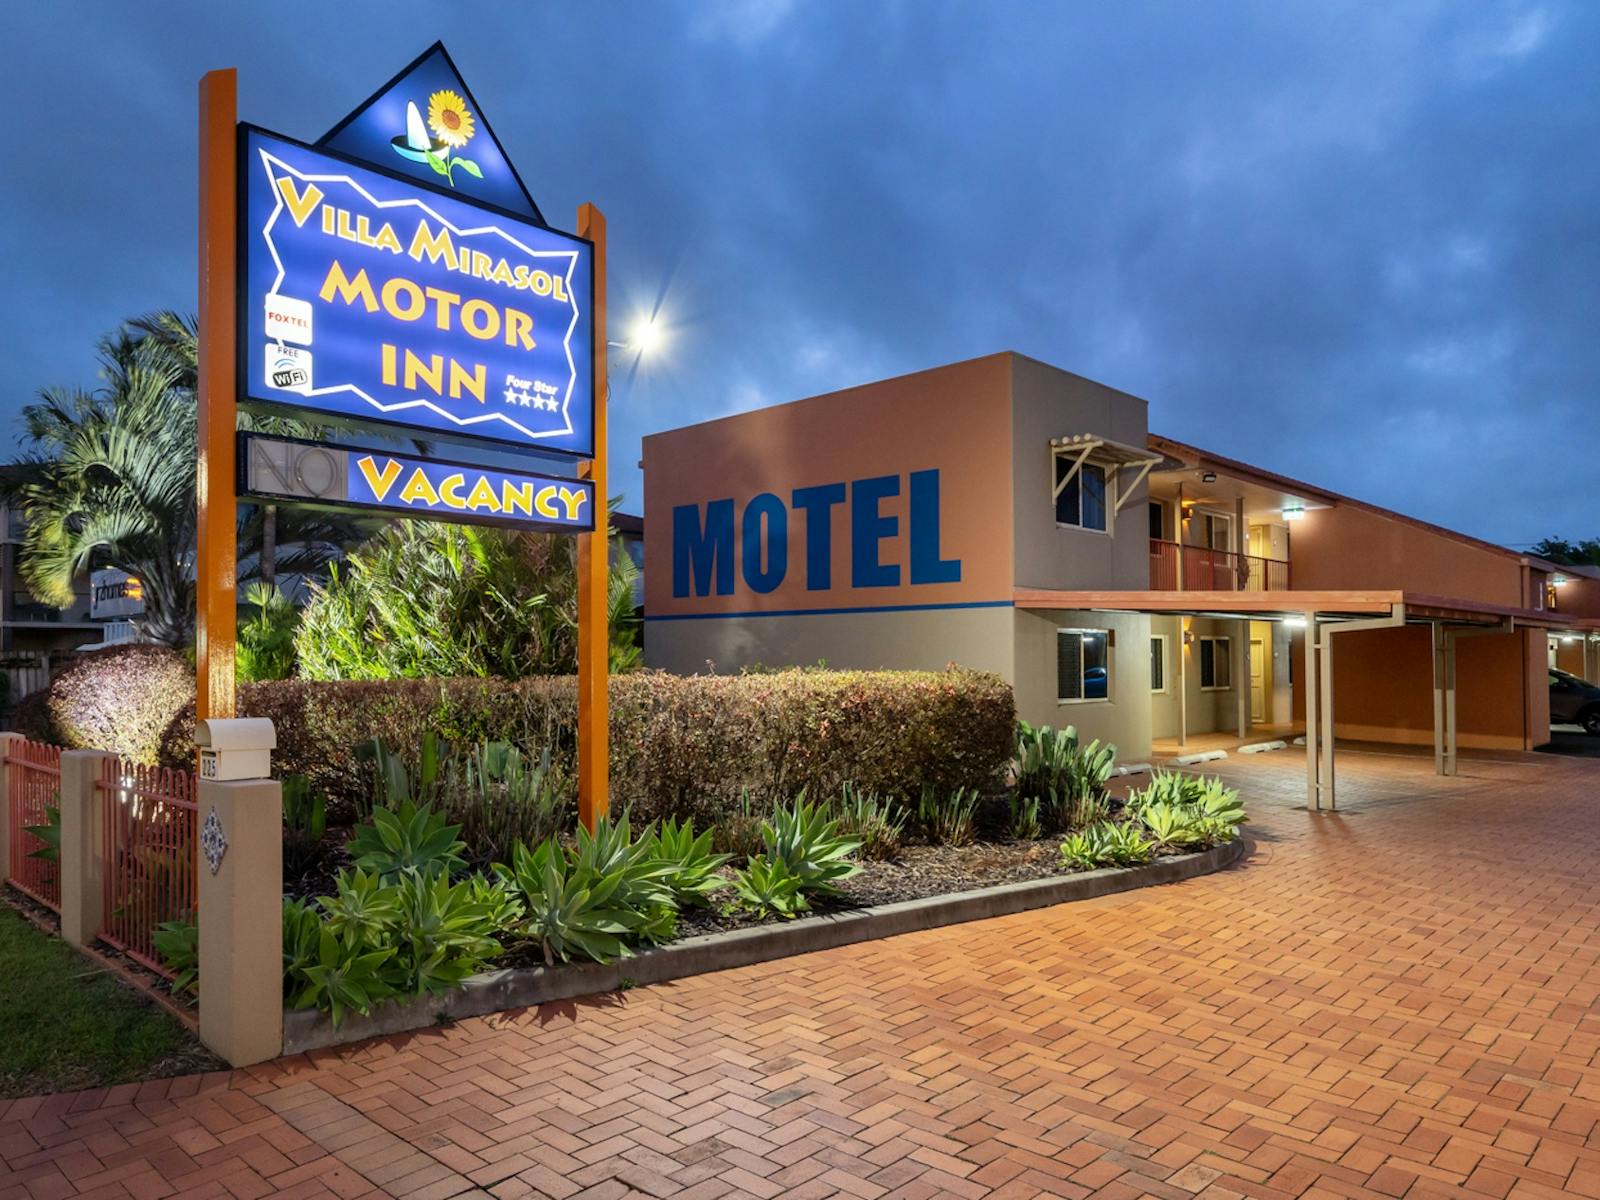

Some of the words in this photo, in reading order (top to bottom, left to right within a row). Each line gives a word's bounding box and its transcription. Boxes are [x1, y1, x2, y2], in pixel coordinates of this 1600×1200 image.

[277, 176, 402, 254] VILLA
[409, 219, 568, 302] MIRASOL
[268, 312, 309, 328] FOXTEL
[319, 261, 537, 351] MOTOR
[277, 346, 299, 358] FREE
[382, 343, 487, 404] INN
[506, 374, 532, 390] Four
[533, 380, 558, 395] Star
[250, 439, 338, 498] NO
[357, 456, 587, 521] VACANCY
[672, 468, 961, 598] MOTEL
